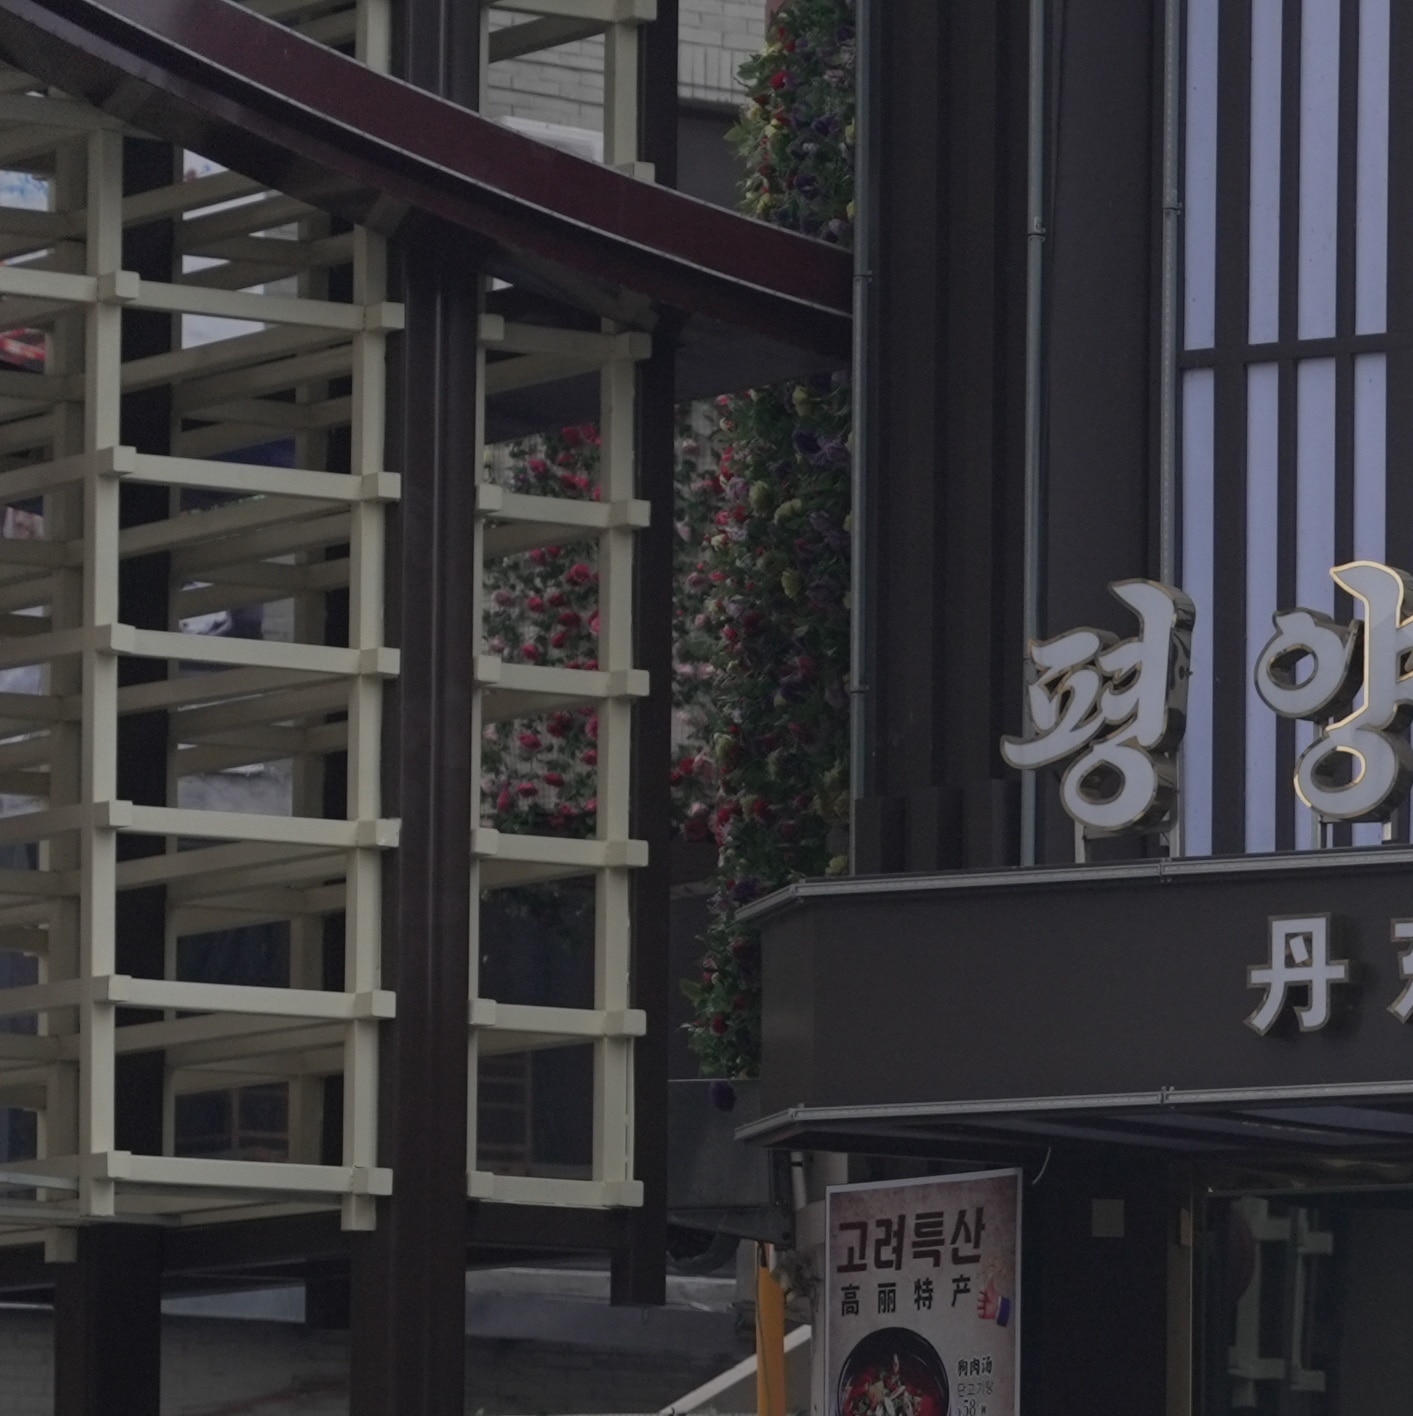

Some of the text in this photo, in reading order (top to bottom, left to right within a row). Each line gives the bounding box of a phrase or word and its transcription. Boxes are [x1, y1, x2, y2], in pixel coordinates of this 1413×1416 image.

[836, 1206, 986, 1273] 고려특산
[841, 1275, 971, 1317] 高丽特产
